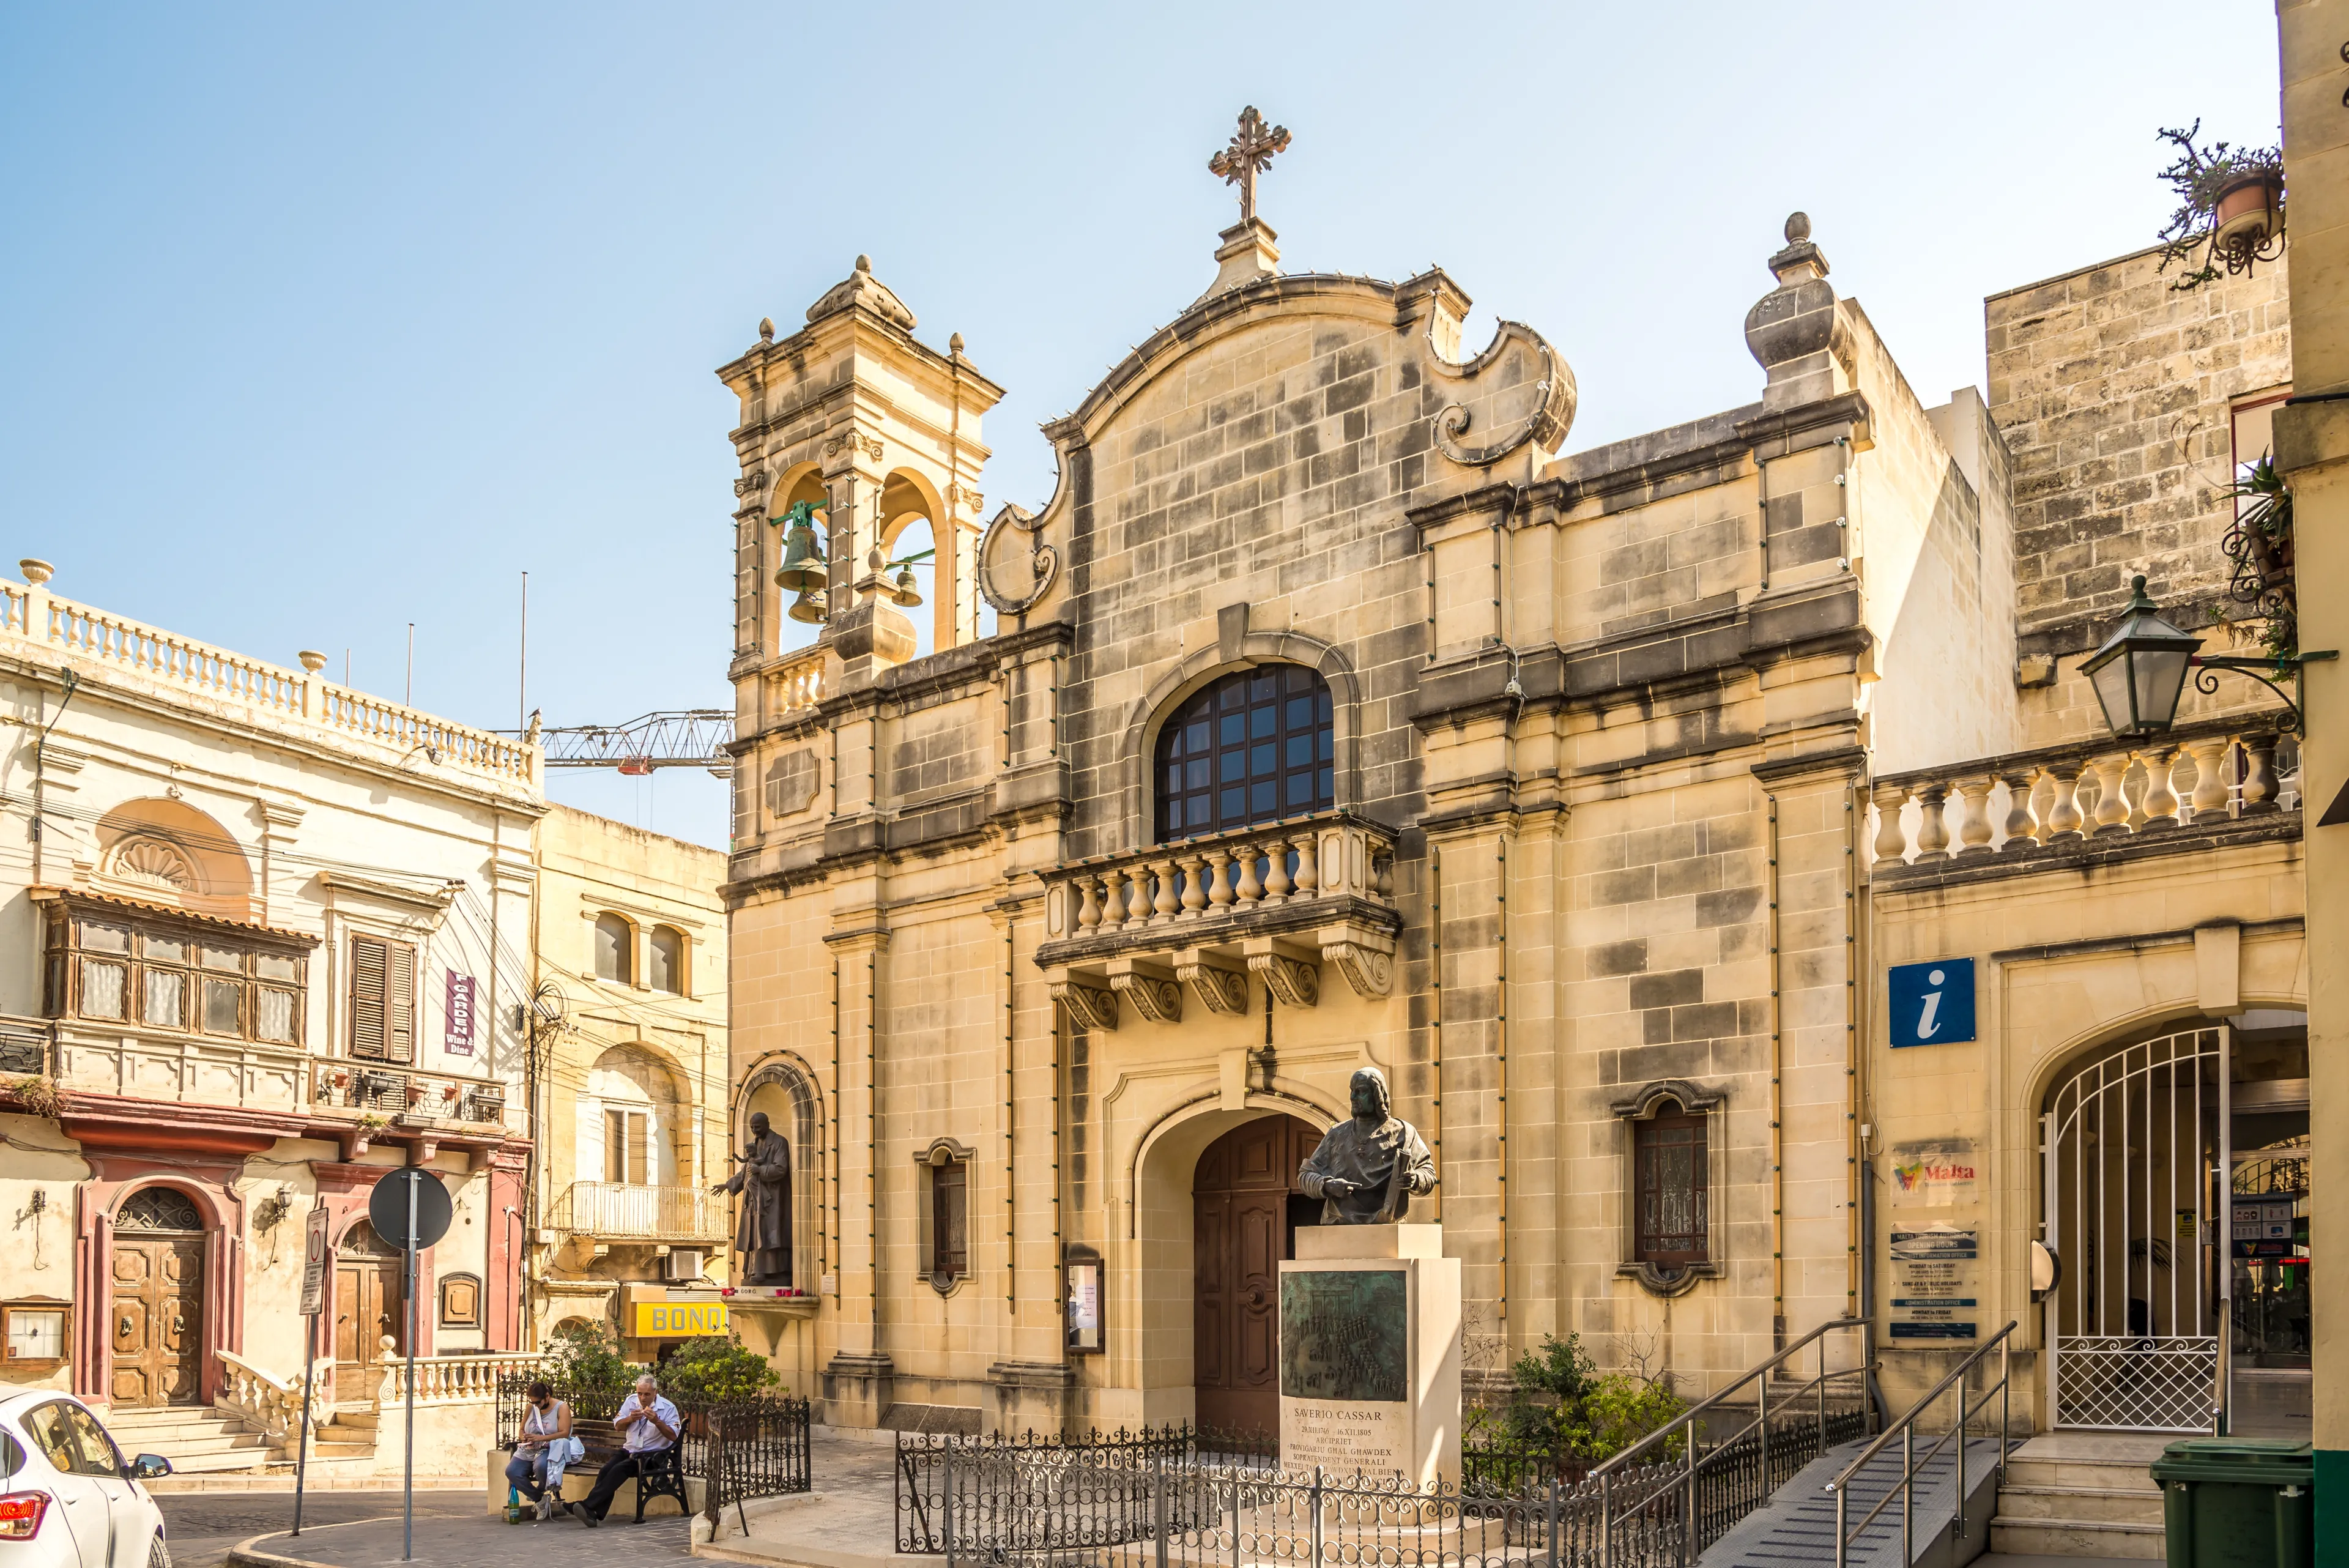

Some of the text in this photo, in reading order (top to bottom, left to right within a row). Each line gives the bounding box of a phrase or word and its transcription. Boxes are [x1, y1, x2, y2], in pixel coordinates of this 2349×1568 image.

[453, 984, 469, 1035] GARDEN
[446, 1033, 473, 1046] Wine &
[451, 1044, 469, 1055] Dine
[1924, 1164, 1974, 1180] Malta
[1294, 1408, 1382, 1421] SAVERIO CASSAR
